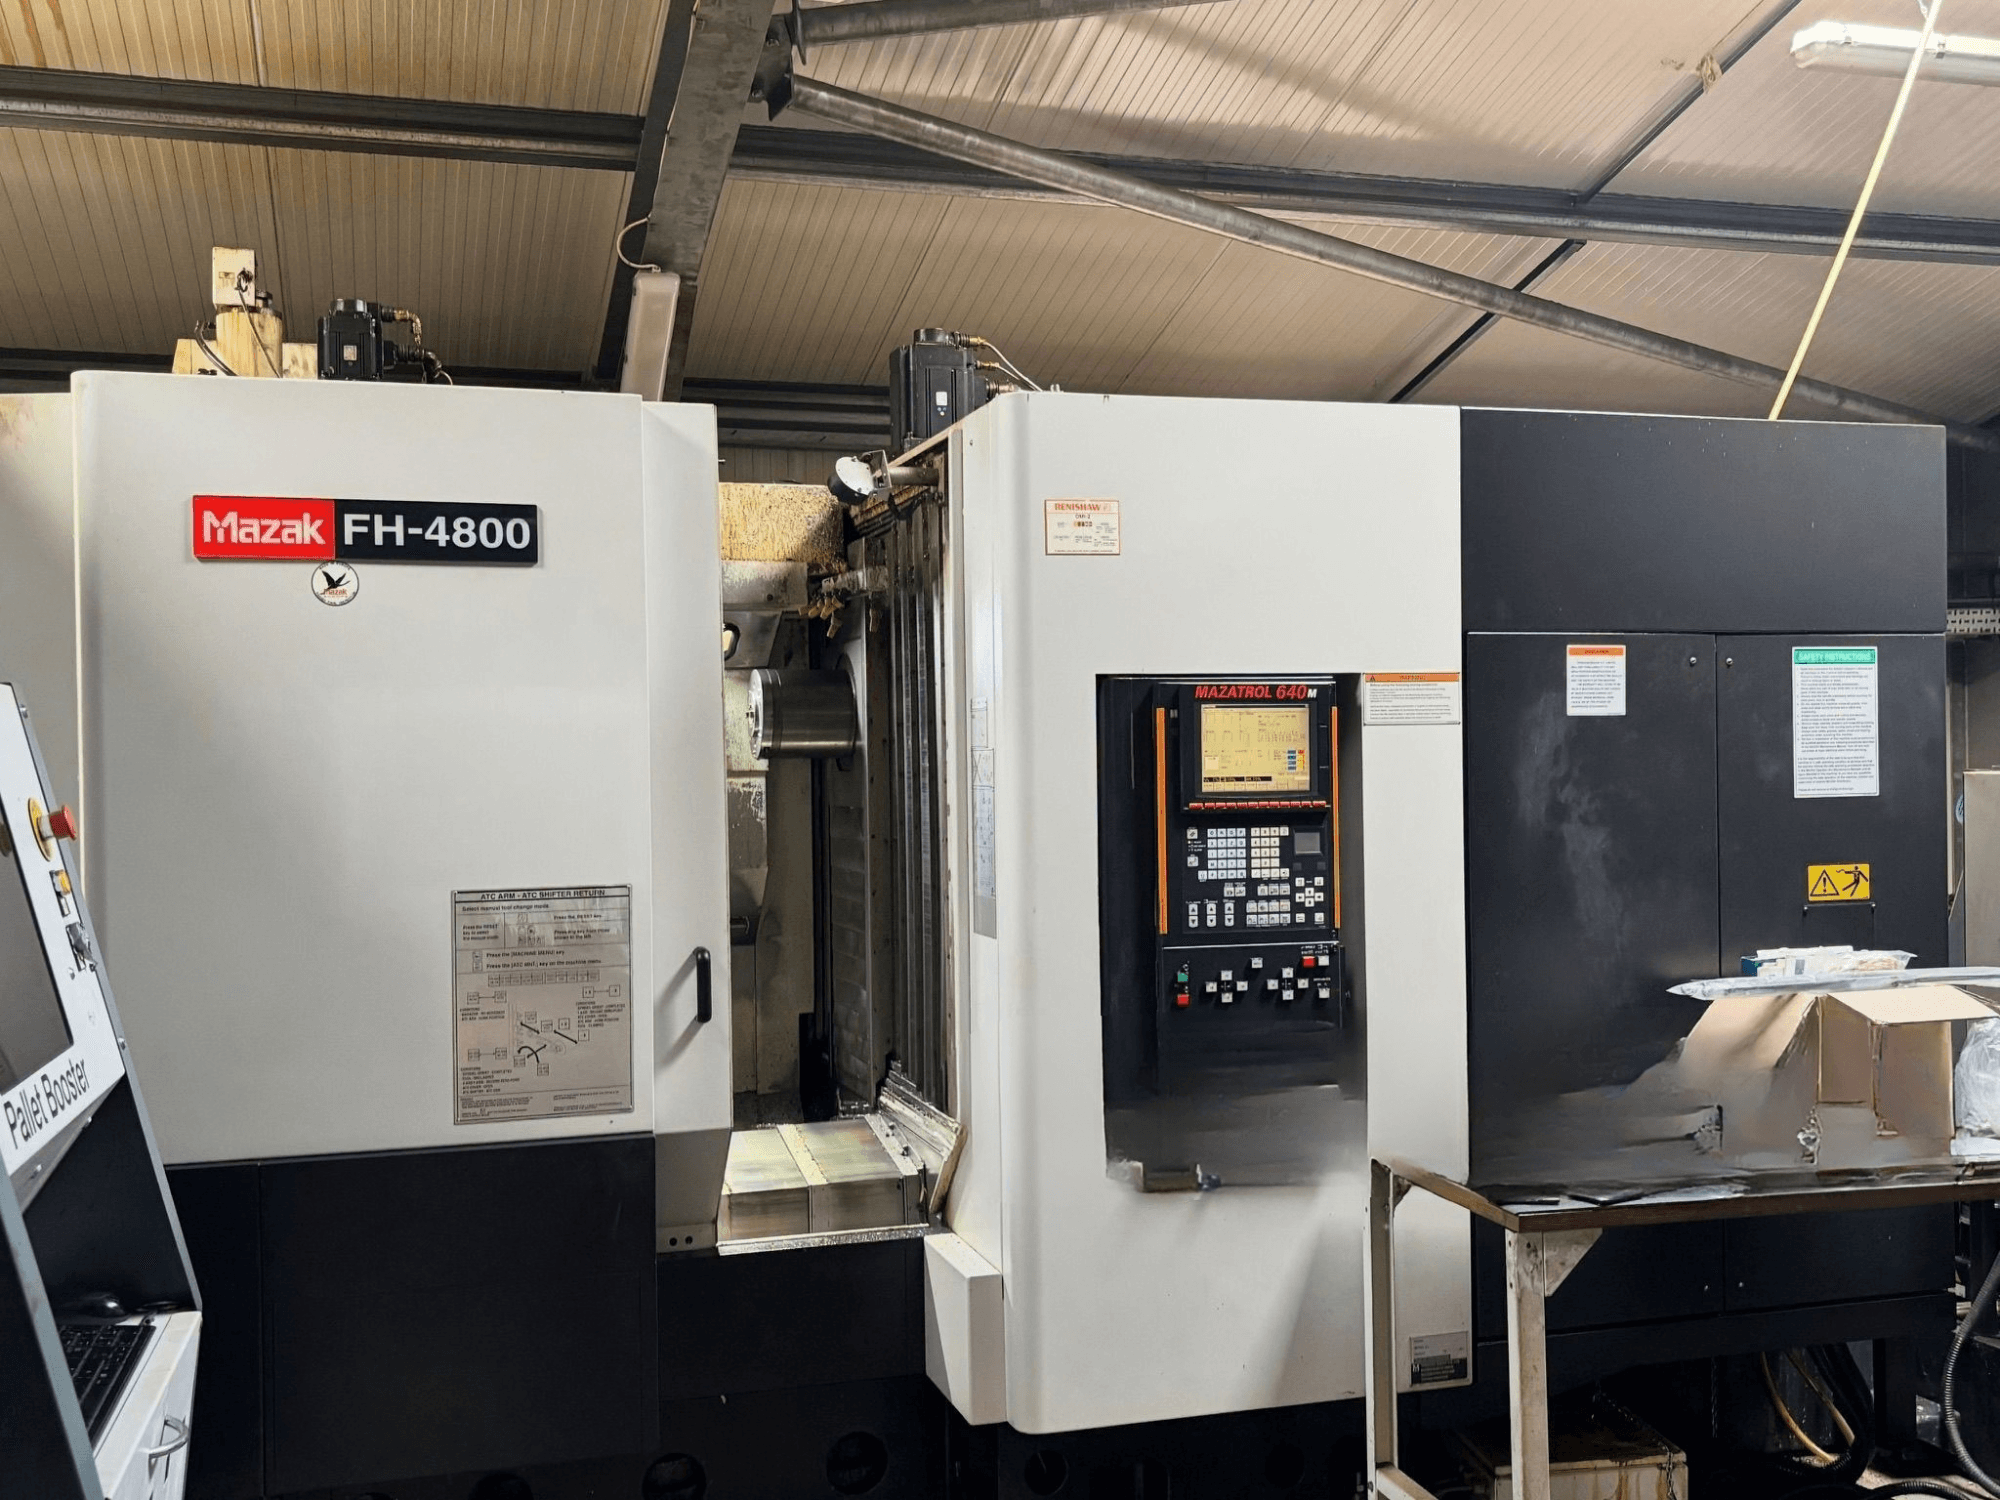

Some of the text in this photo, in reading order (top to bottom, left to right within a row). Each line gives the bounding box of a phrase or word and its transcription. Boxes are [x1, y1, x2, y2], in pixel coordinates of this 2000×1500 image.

[1054, 502, 1101, 511] RENISHAW
[202, 509, 531, 550] Mazak FH-4800
[1194, 685, 1273, 699] MAZATROL
[480, 892, 497, 900] ATC
[521, 891, 538, 899] ATC
[539, 890, 573, 898] SHIFTER
[573, 889, 606, 897] RETURN
[3, 1058, 90, 1150] Pallet Booster
